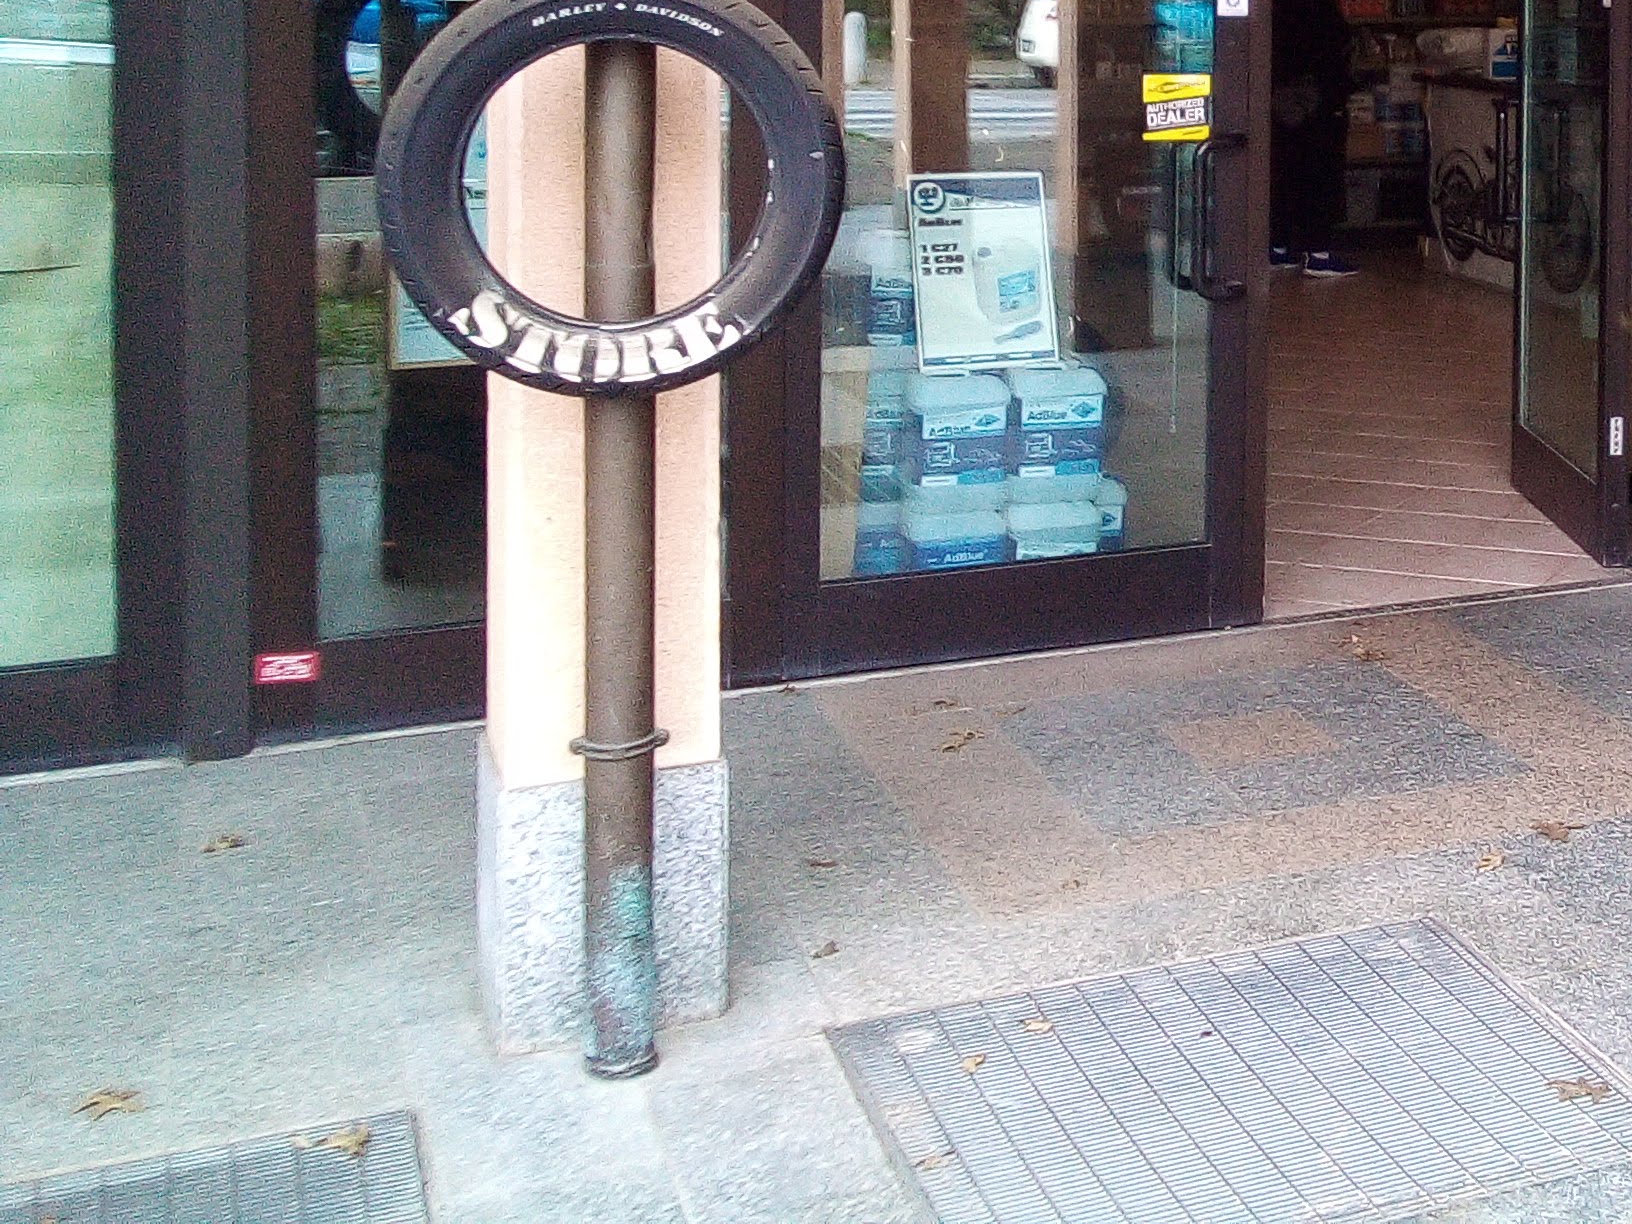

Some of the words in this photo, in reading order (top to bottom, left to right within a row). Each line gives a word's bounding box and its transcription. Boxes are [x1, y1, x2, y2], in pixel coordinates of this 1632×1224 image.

[532, 2, 607, 27] HARLEY
[634, 3, 725, 37] DAVIDSON
[1147, 97, 1205, 114] AUTHORIZED
[1147, 107, 1206, 127] DEALER
